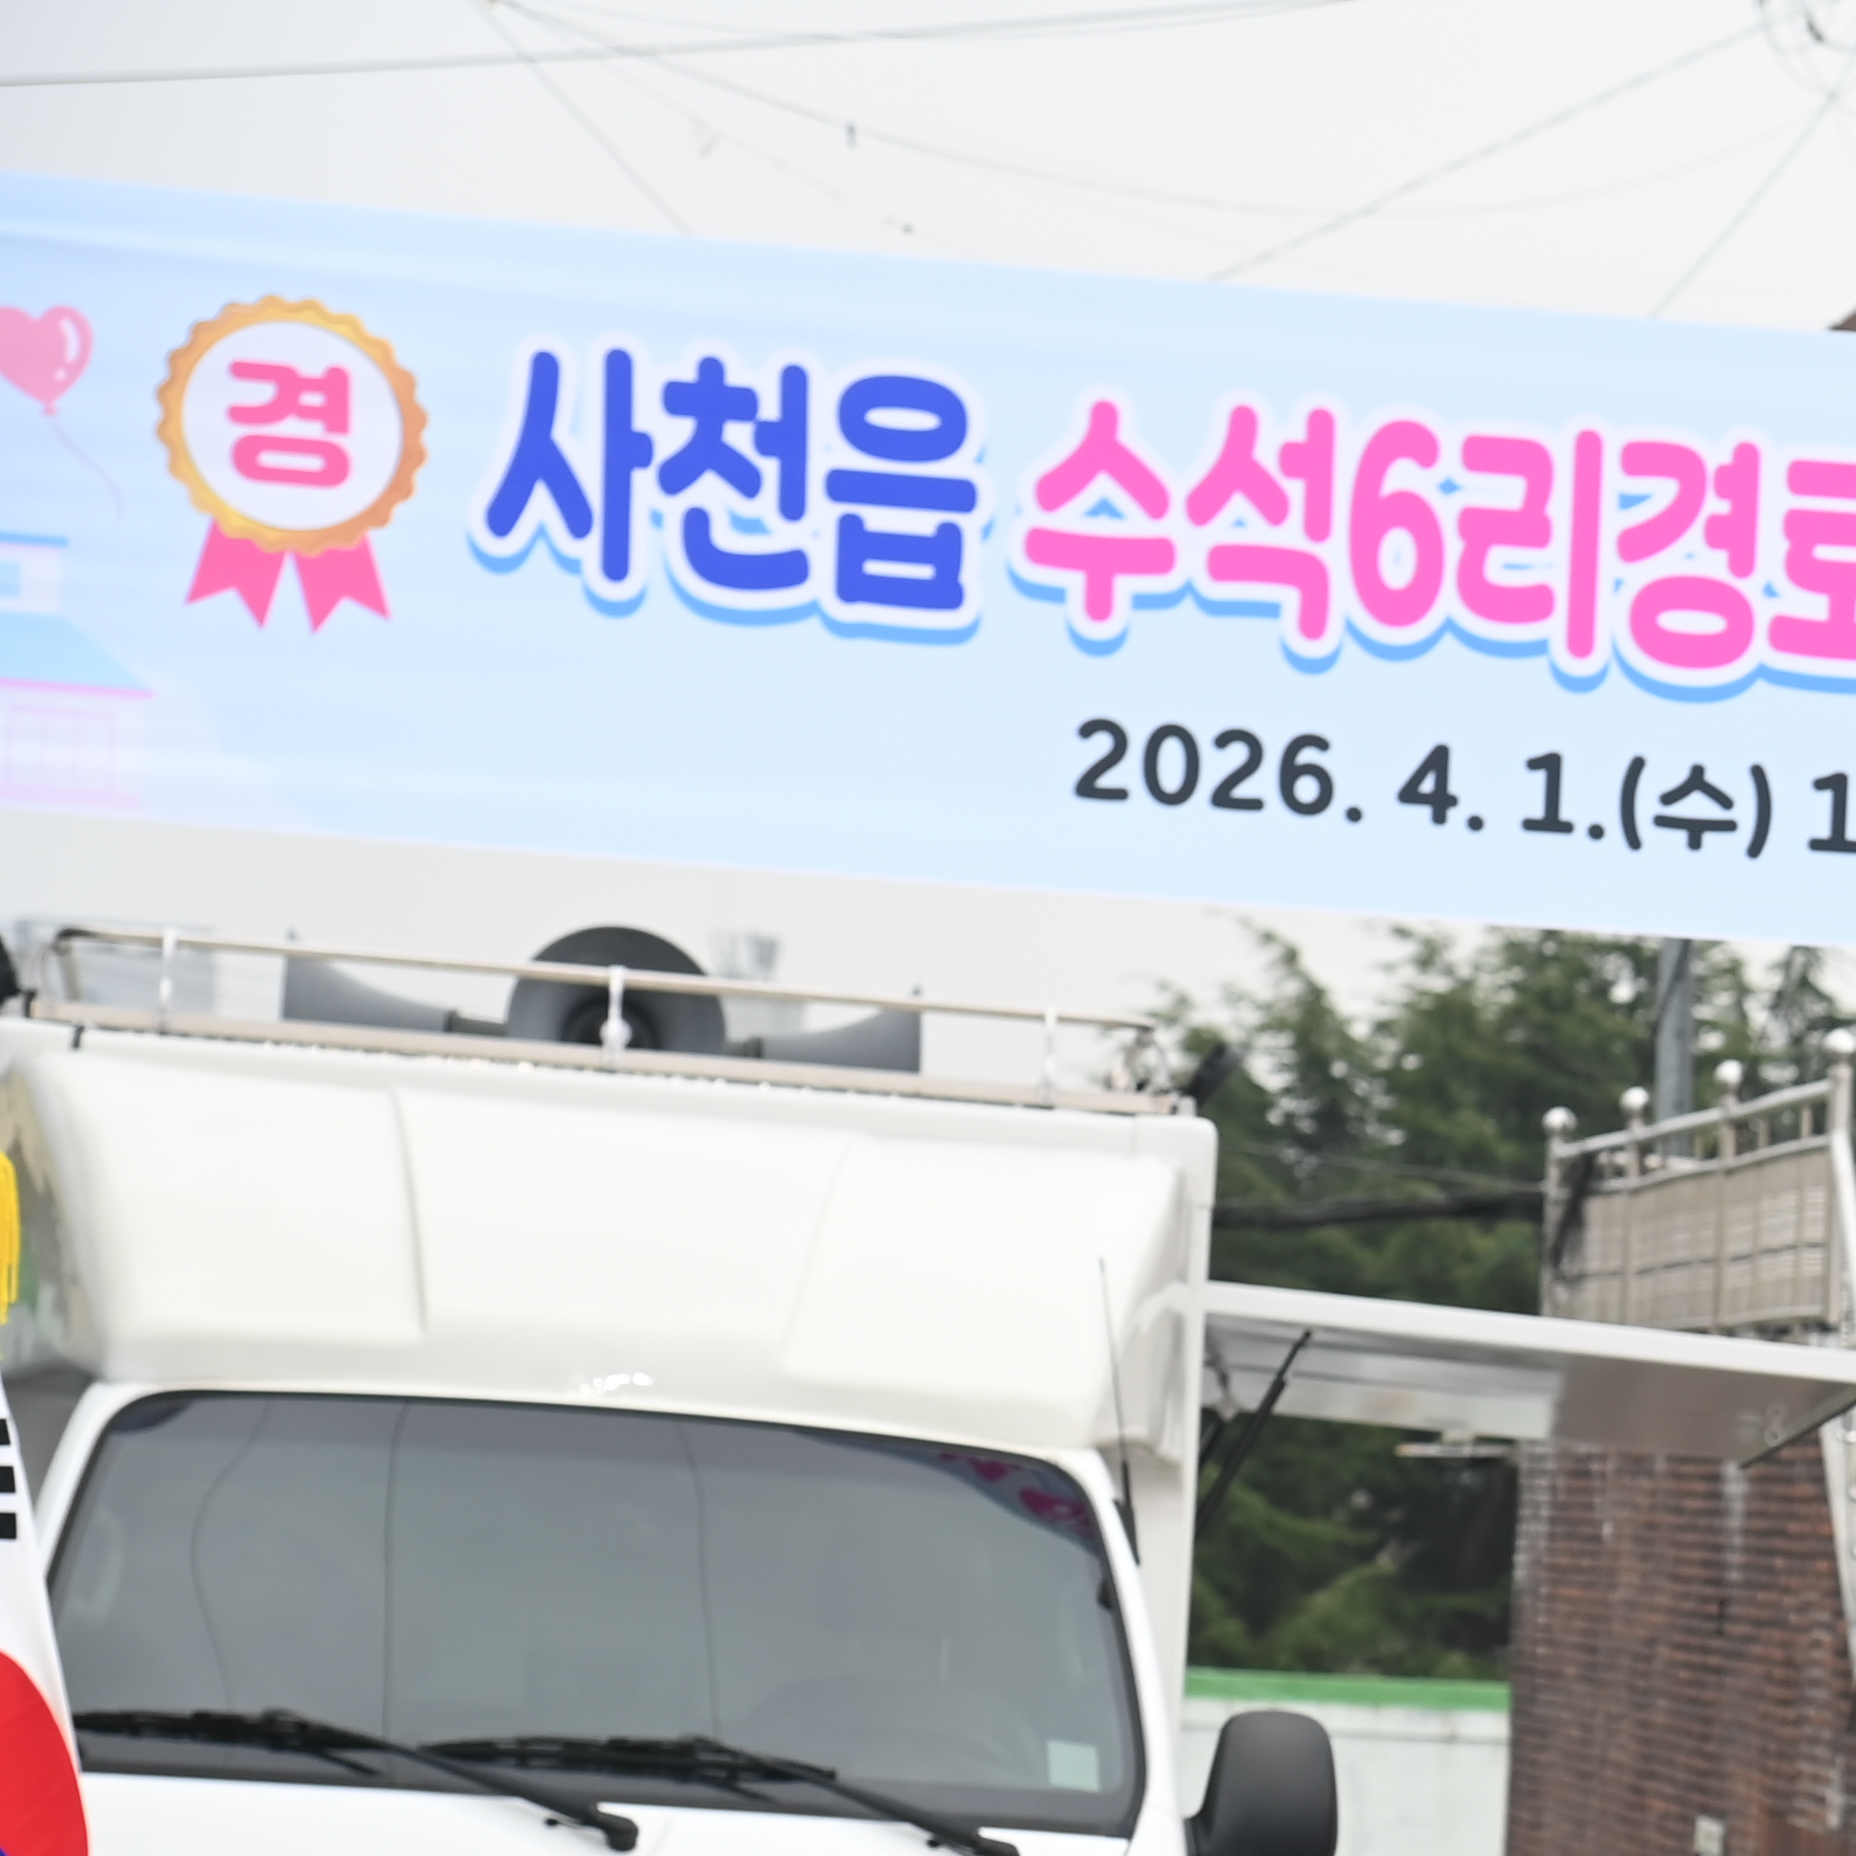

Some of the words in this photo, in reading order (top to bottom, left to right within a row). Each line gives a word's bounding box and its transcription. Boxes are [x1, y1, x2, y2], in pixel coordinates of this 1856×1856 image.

[228, 360, 351, 488] 경
[486, 348, 977, 611] 사천읍
[1074, 717, 1364, 824] 2026.
[1396, 743, 1485, 833] 4.
